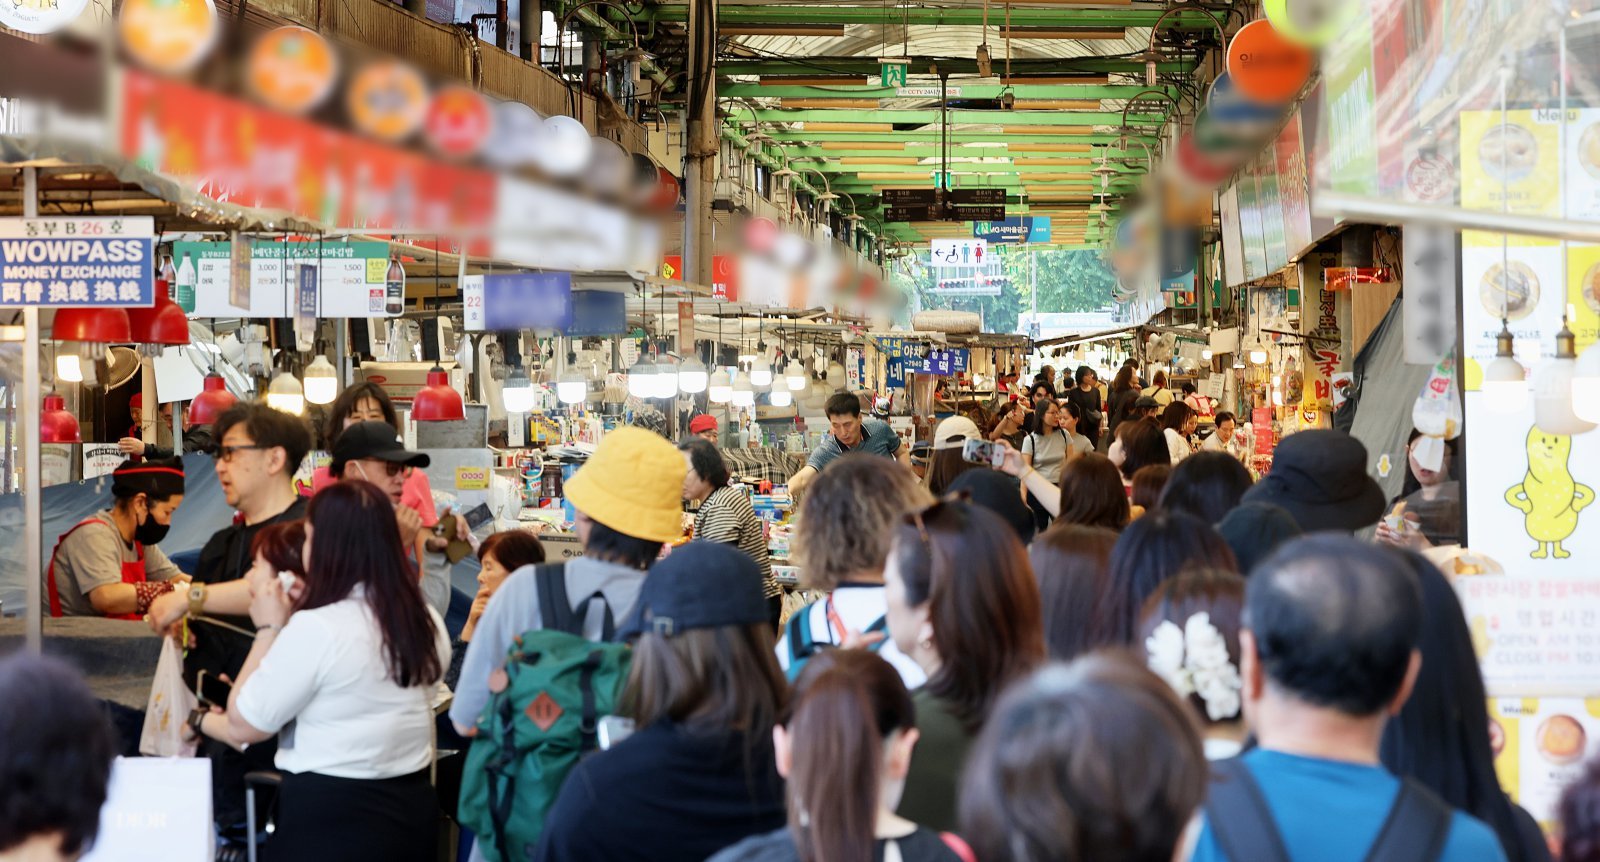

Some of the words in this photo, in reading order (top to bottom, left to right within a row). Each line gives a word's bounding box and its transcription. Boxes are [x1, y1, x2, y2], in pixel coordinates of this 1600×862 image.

[2, 240, 144, 263] WOWPASS
[4, 265, 59, 280] MONEY
[61, 265, 142, 280] EXCHANGE
[467, 296, 481, 308] 22
[848, 370, 858, 379] 15
